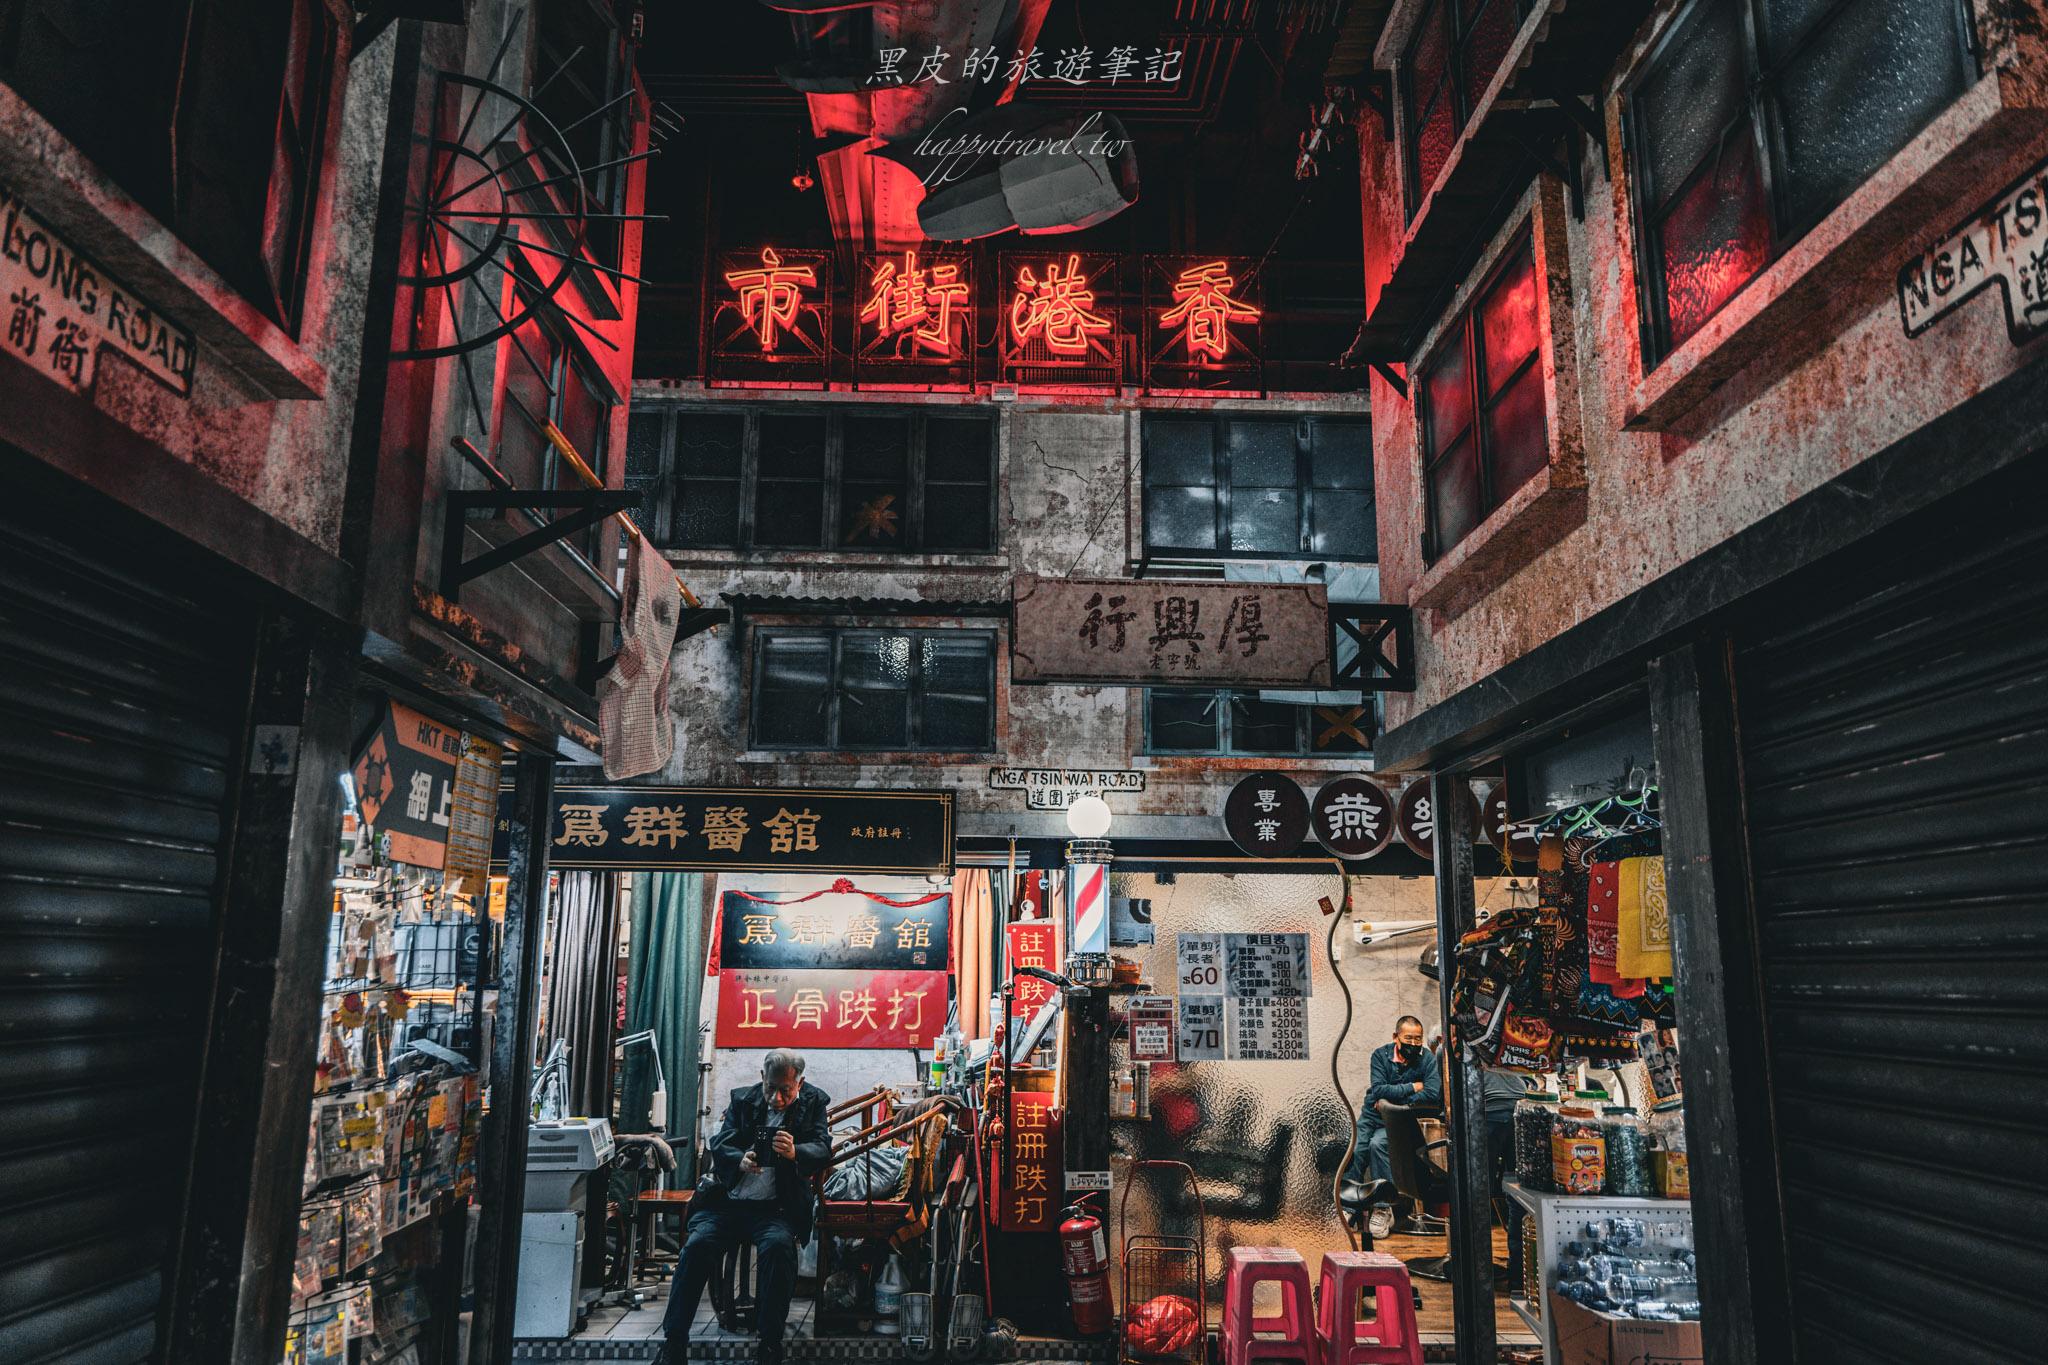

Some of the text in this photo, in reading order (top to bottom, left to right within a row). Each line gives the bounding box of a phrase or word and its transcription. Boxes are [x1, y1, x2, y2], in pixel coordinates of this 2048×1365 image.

[1905, 234, 1984, 318] NGA
[107, 290, 191, 377] ROAD
[1149, 653, 1201, 672] 老字號
[416, 720, 442, 749] HKT
[997, 773, 1138, 787] NGA TSIN WAI ROAD
[1254, 789, 1281, 842] 專業
[1186, 941, 1213, 951] 單剪
[1246, 934, 1286, 945] 價目表
[1186, 953, 1214, 964] 長者
[1271, 946, 1290, 955] $70
[1271, 961, 1291, 970] $80
[1182, 966, 1218, 985] $60
[1272, 970, 1291, 978] $100
[1272, 978, 1291, 987] $40
[738, 987, 928, 1031] 正骨跌打
[1188, 1005, 1216, 1016] 單剪
[1183, 1029, 1219, 1049] $70
[1015, 1102, 1048, 1226] 註冊跌打
